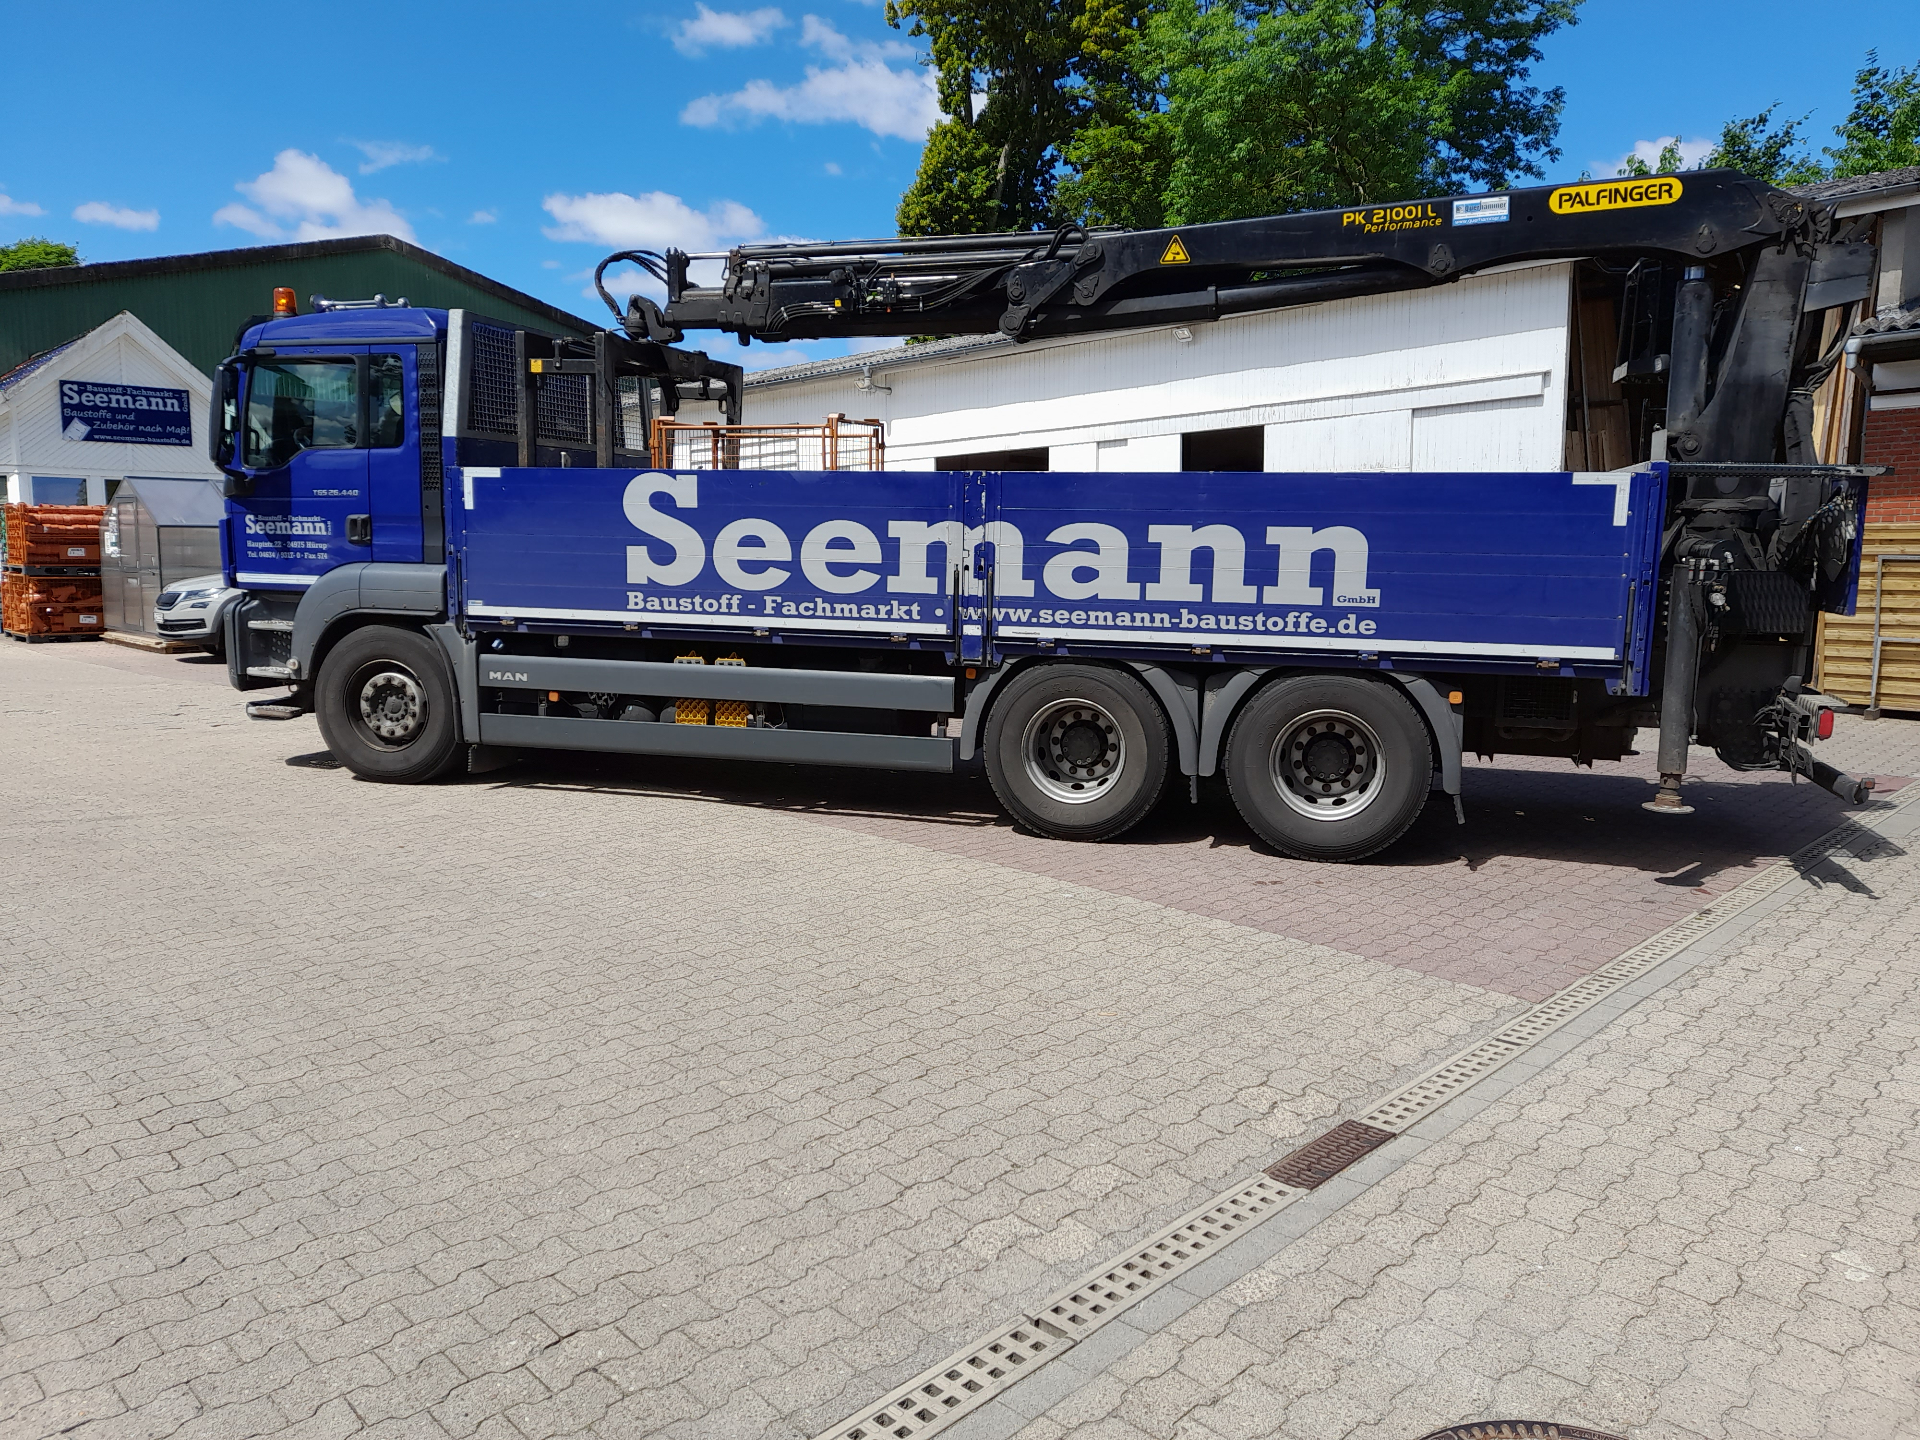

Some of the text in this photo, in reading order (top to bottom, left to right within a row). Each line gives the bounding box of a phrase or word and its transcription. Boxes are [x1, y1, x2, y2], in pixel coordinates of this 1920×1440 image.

[1558, 182, 1674, 209] PALFINGER
[1343, 211, 1366, 227] PK
[1372, 205, 1422, 223] 21001
[1428, 204, 1437, 217] L
[1364, 218, 1443, 234] Performance
[62, 384, 180, 412] Seemann
[63, 408, 135, 420] Baustoffe und
[93, 421, 190, 435] Zubehör nach Maß!
[93, 434, 191, 445] www.seemann-baustoffe.de
[245, 514, 327, 535] Seemann
[622, 472, 1381, 607] Seemann
[1337, 595, 1376, 604] GmbH
[626, 591, 743, 613] Baustoff
[763, 596, 921, 620] Fachmarkt
[958, 607, 1377, 635] www.seemann-baustoffe.de
[489, 671, 528, 682] MAN
